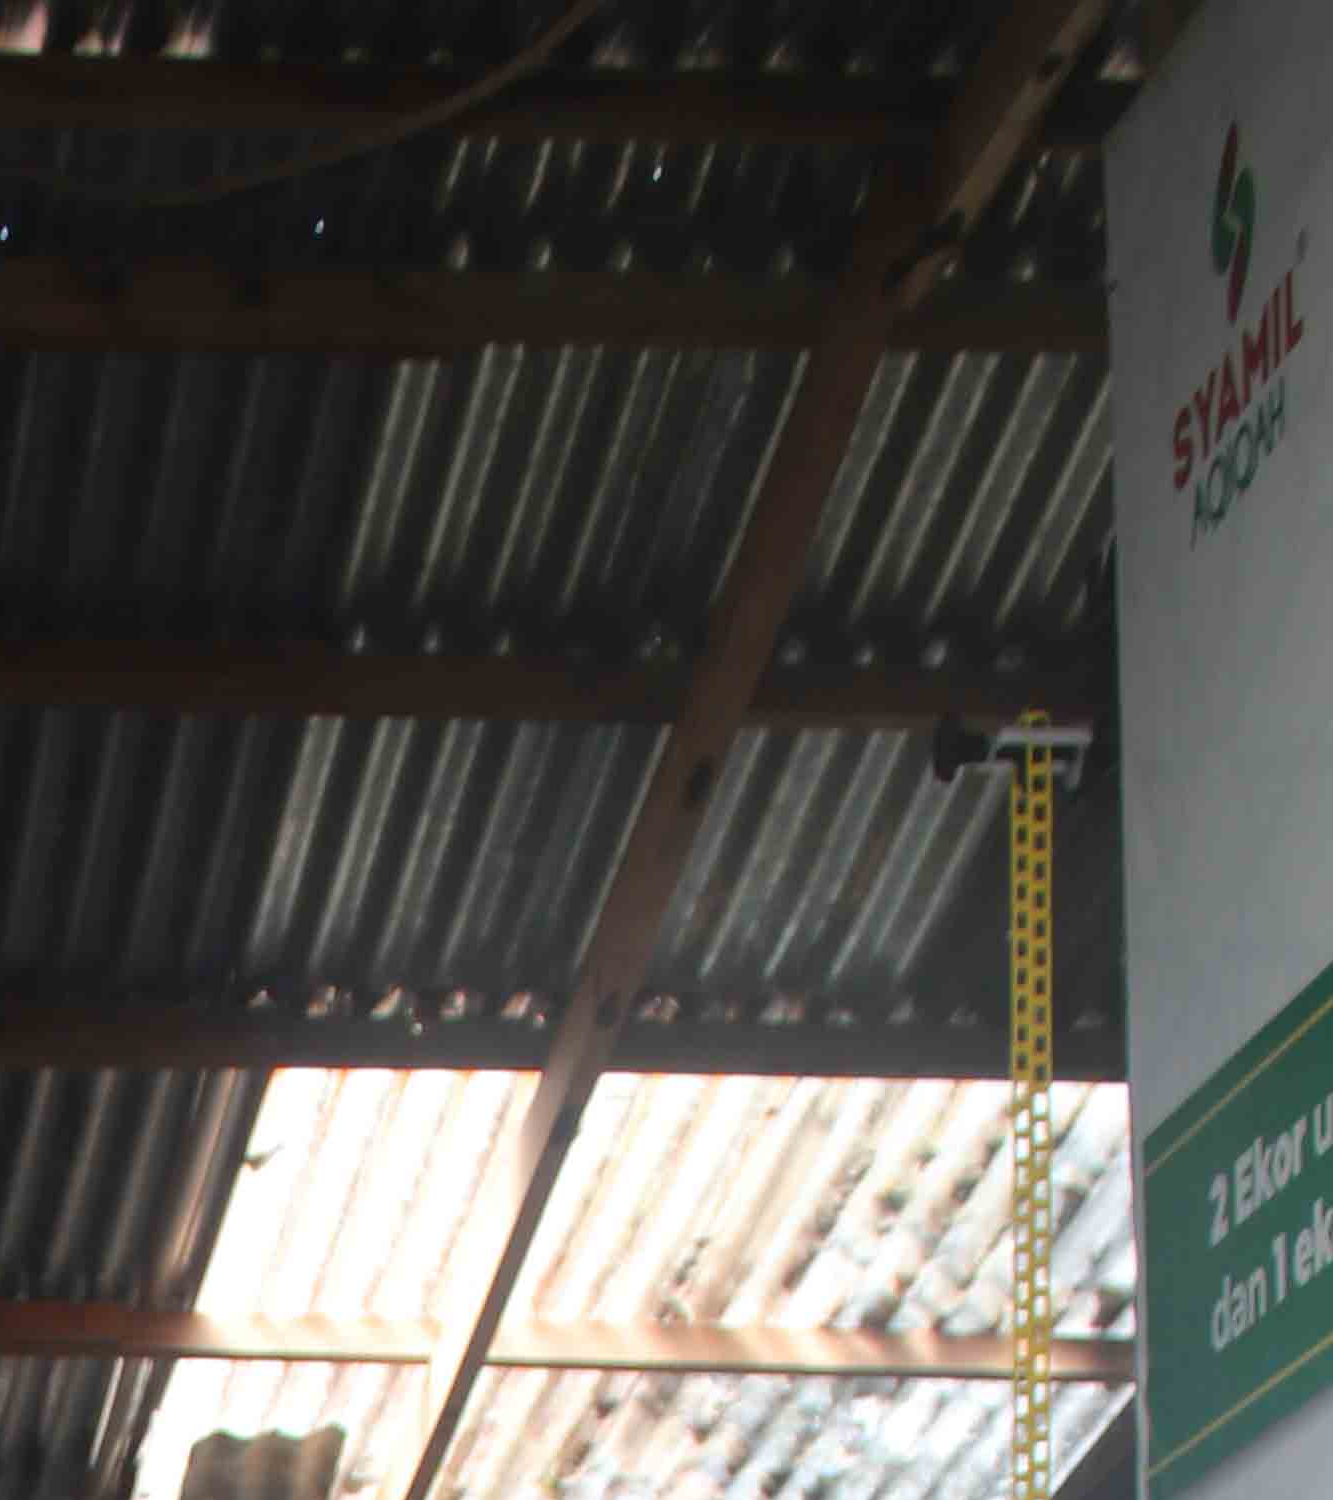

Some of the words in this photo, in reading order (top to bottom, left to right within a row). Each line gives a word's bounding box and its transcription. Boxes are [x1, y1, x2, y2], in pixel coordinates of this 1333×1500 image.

[1173, 270, 1305, 490] SYAMIL
[1208, 1171, 1229, 1248] 2
[1234, 1114, 1307, 1226] Ekor
[1212, 1265, 1267, 1352] dan
